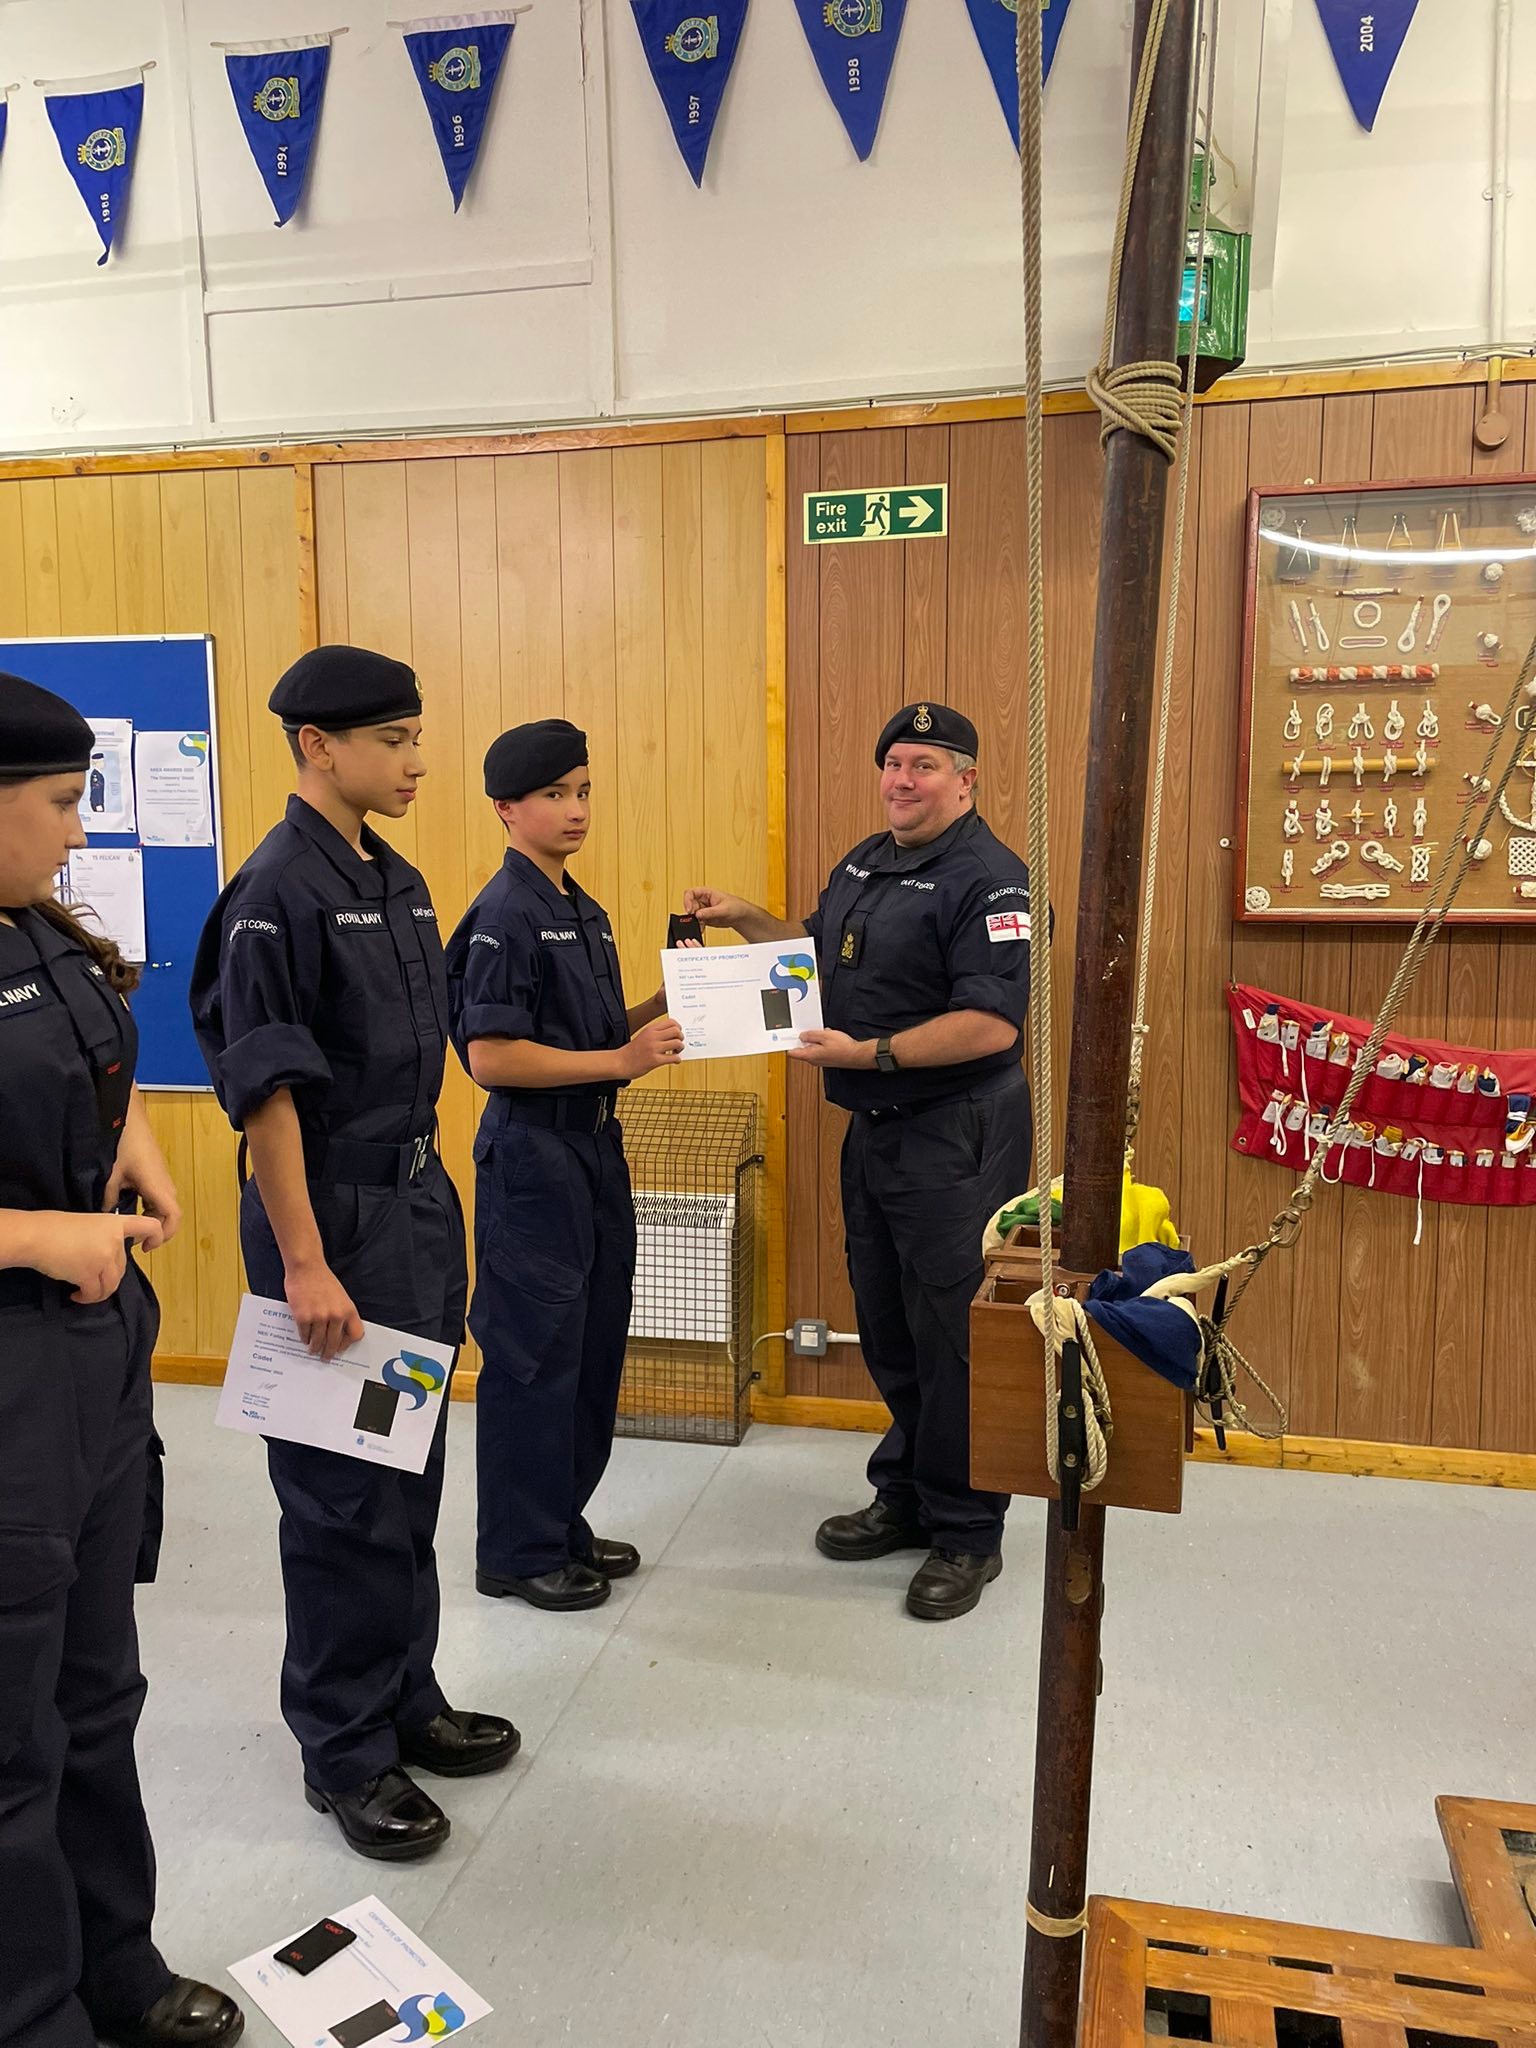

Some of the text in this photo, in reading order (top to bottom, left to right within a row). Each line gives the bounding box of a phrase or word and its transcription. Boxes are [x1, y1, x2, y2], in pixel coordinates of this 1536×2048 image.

[1360, 15, 1374, 52] 2004
[848, 58, 861, 92] 1998
[688, 95, 700, 124] 1997
[452, 115, 465, 147] 1996
[816, 501, 847, 516] Fire
[816, 518, 847, 533] exit
[987, 891, 1001, 902] SEA
[999, 886, 1017, 896] CADET
[248, 919, 278, 935] CORPS
[2, 982, 41, 1004] NAVY
[252, 1352, 273, 1362] Cadet
